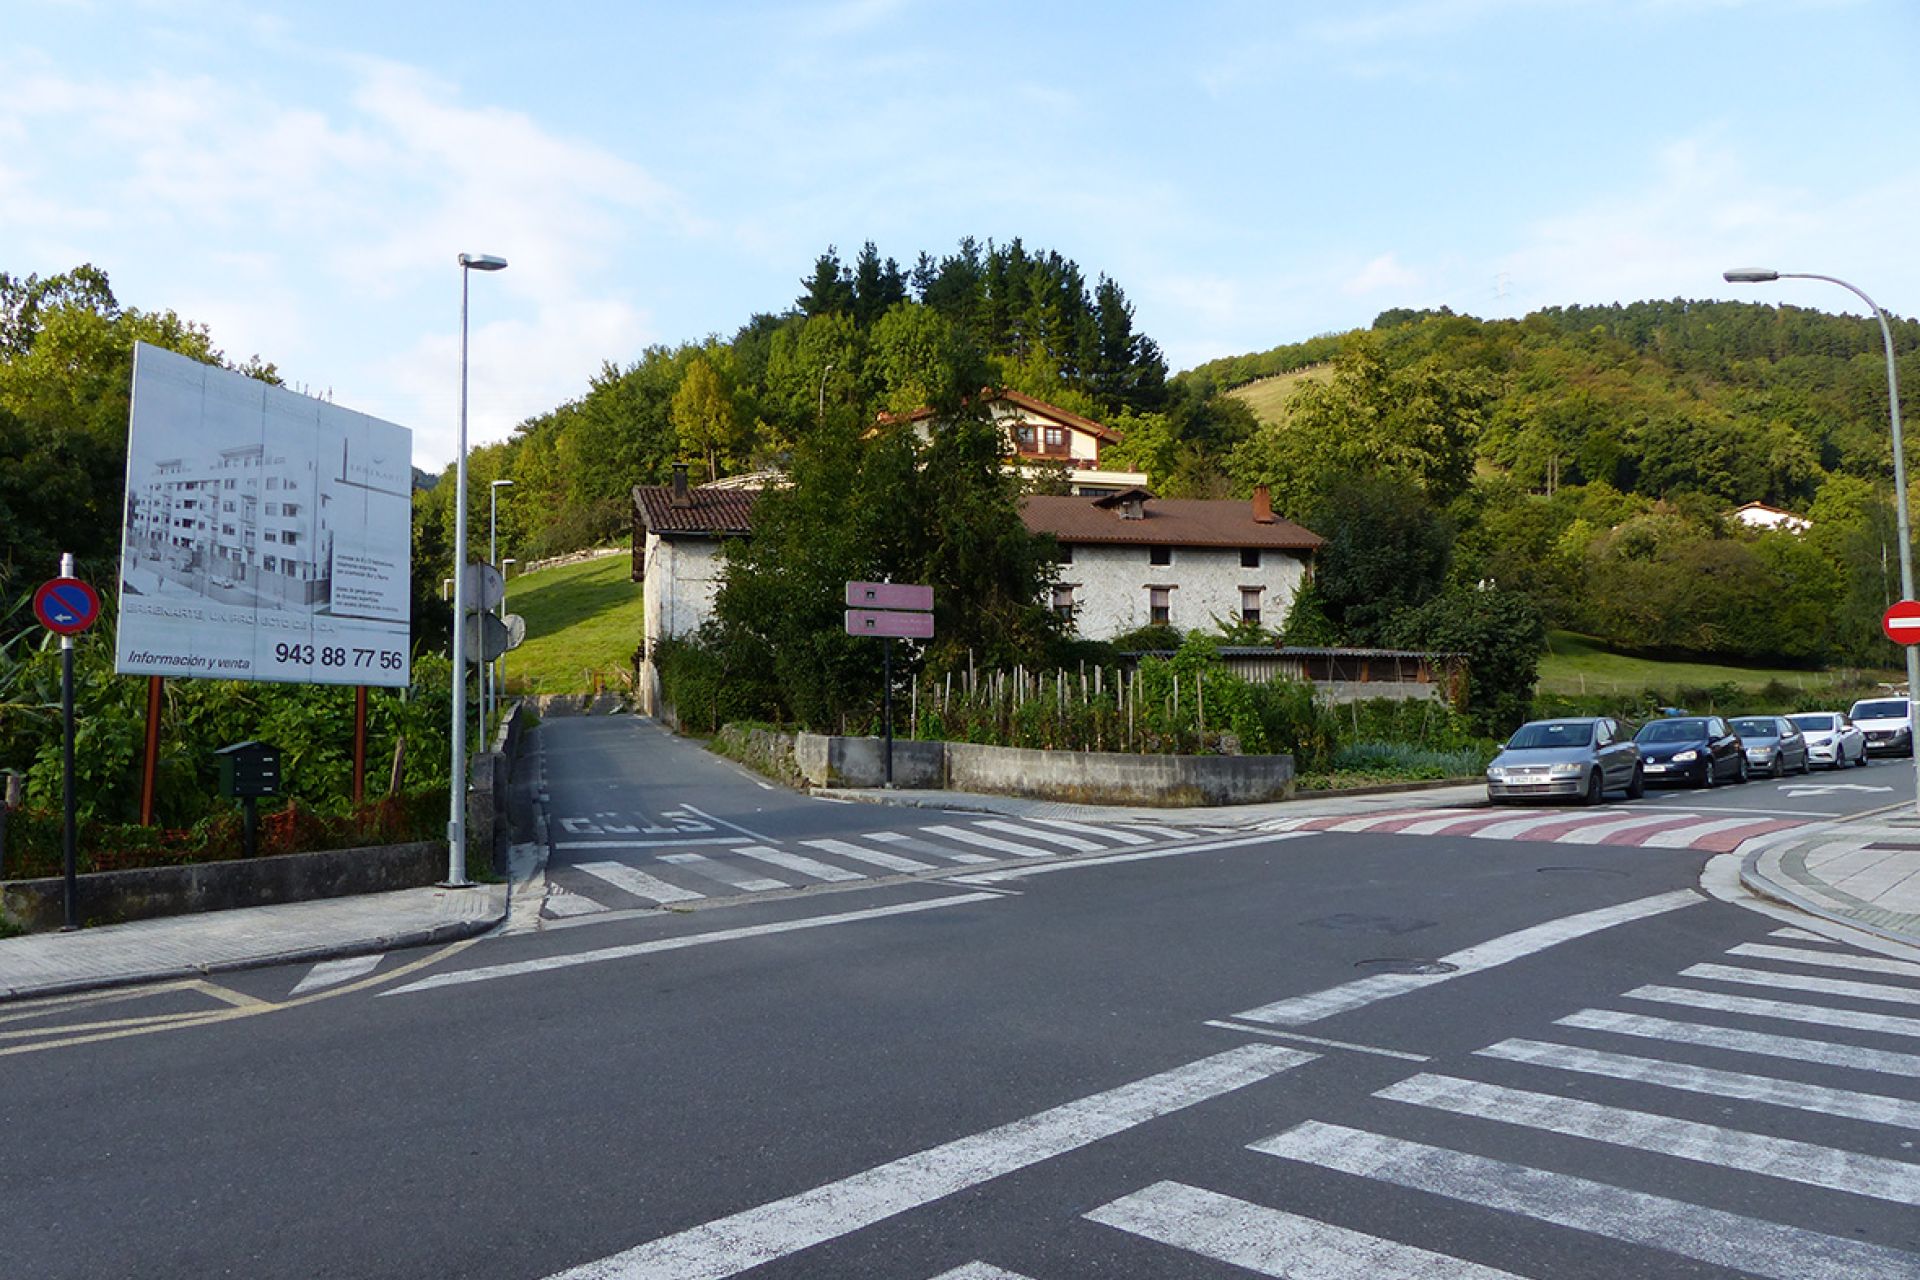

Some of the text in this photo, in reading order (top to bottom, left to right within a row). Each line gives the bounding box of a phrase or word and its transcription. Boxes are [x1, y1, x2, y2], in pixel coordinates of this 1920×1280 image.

[128, 650, 251, 671] Información y venta
[275, 643, 403, 670] 943 88 77 56
